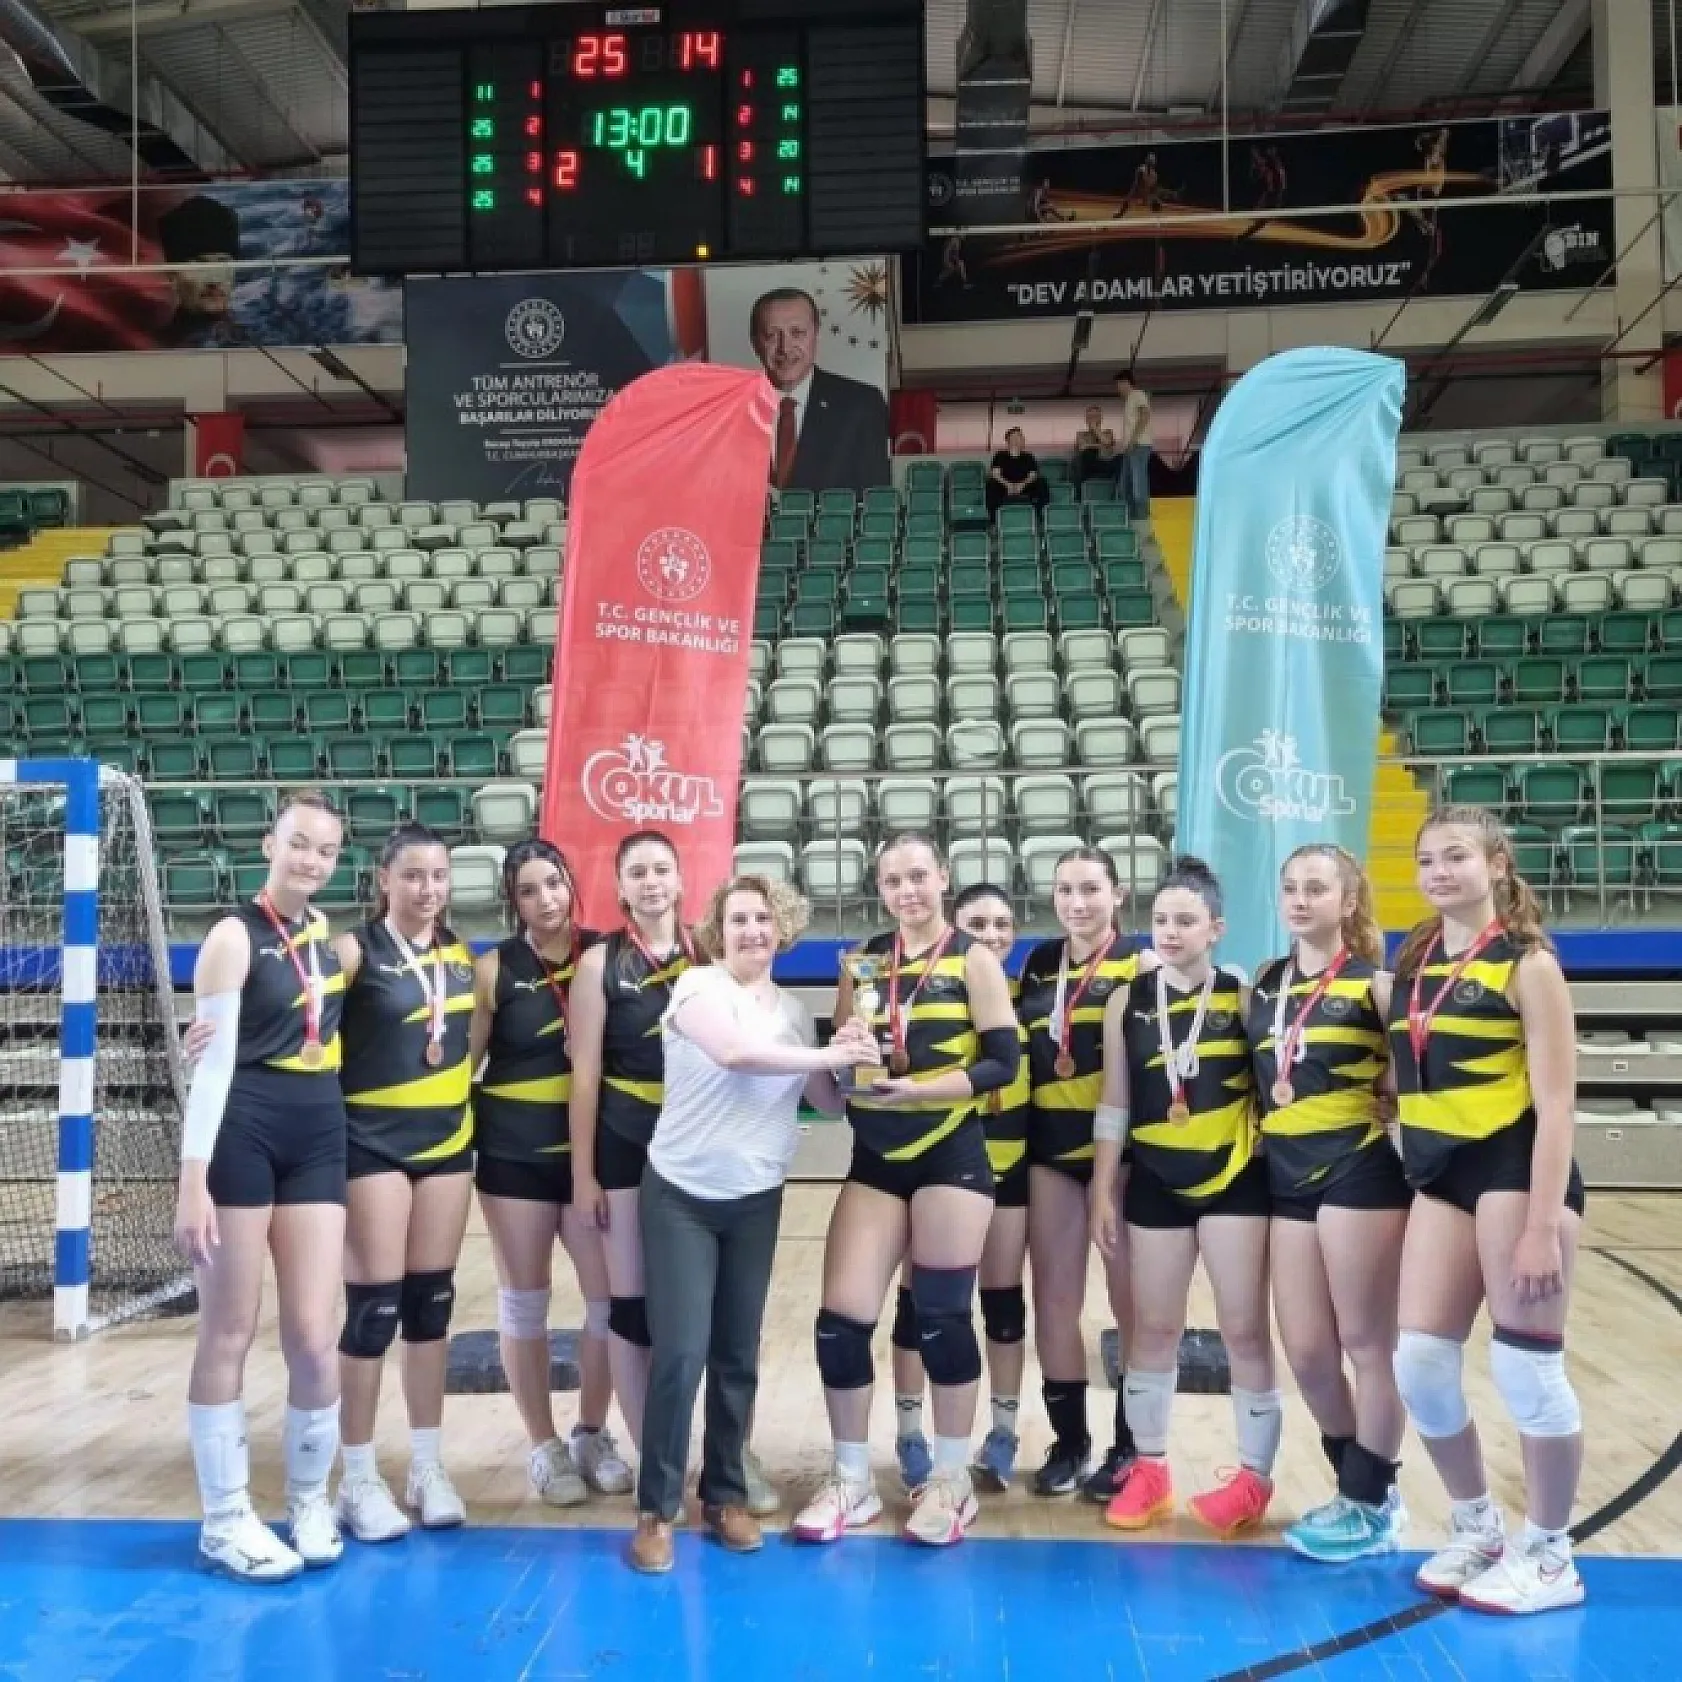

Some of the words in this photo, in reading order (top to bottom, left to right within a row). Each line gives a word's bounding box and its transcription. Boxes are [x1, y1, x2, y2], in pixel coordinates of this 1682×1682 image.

[575, 34, 625, 76] 25
[681, 31, 719, 71] 14
[743, 69, 751, 88] 1
[476, 84, 494, 101] 11
[531, 80, 541, 100] 1
[737, 104, 752, 126] 2
[526, 116, 541, 136] 2
[592, 106, 690, 146] 13:00
[738, 140, 752, 160] 3
[527, 151, 542, 172] 3
[555, 151, 577, 187] 2
[627, 149, 644, 179] 4
[703, 145, 715, 179] 1
[738, 178, 752, 196] 4
[527, 189, 542, 207] 4
[1073, 273, 1195, 303] ADAMLAR
[471, 374, 509, 391] TÜM
[512, 370, 599, 390] ANTRENÖR
[453, 391, 474, 408] VE
[1226, 594, 1259, 611] T.C.
[597, 602, 628, 619] T.C.
[634, 606, 712, 631] GENÇLİK
[717, 617, 739, 634] VE
[1224, 615, 1273, 632] SPOR
[595, 622, 641, 641] SPOR
